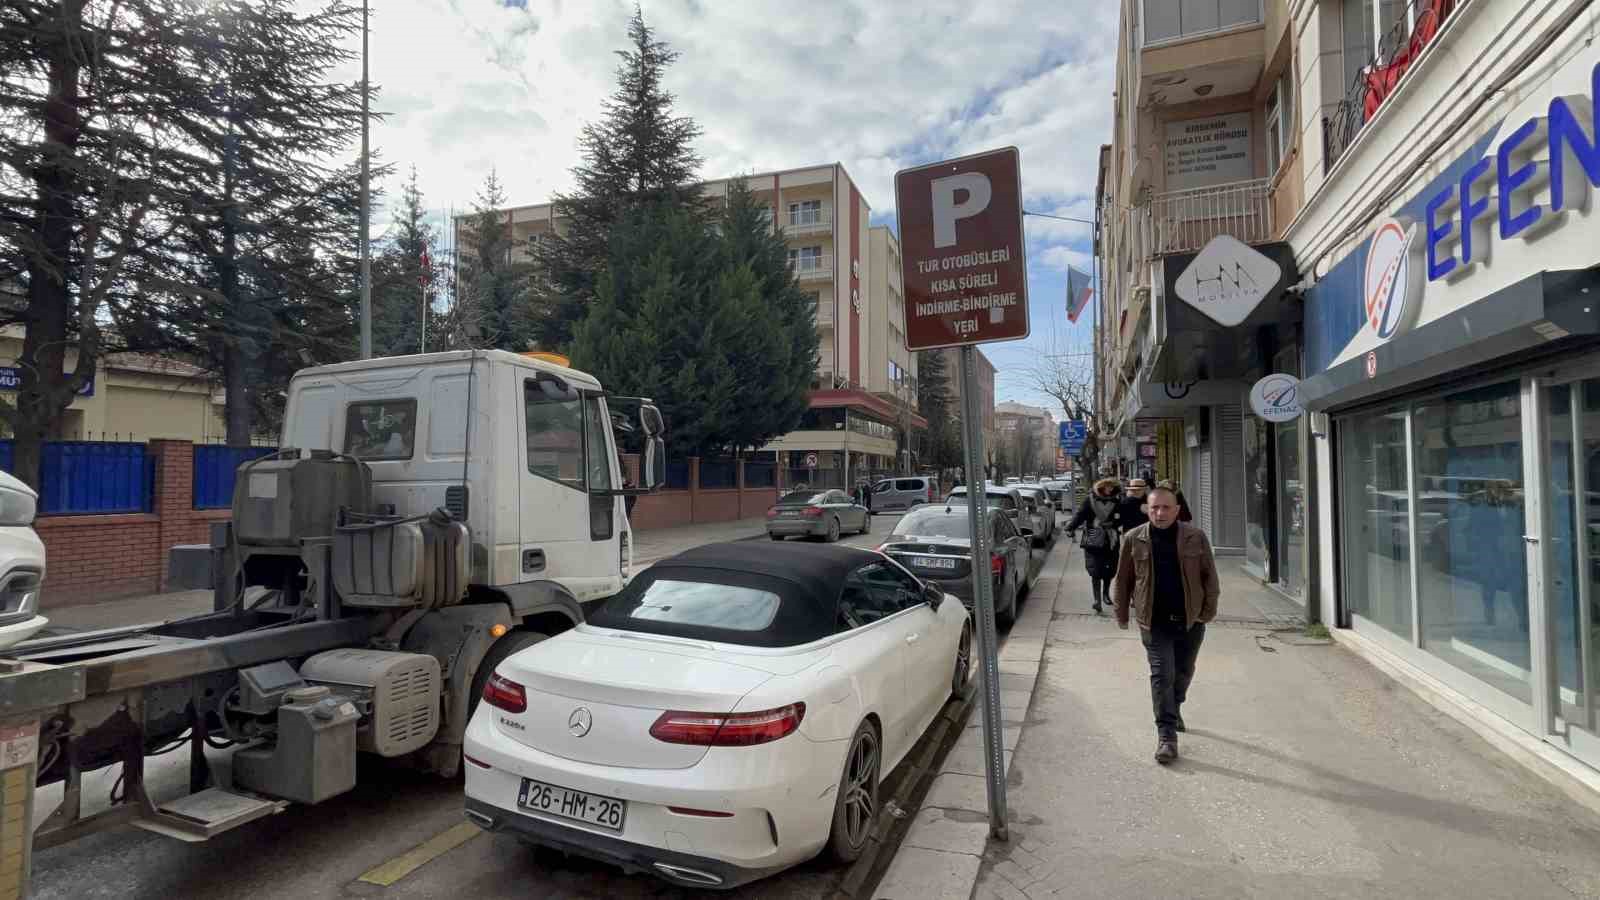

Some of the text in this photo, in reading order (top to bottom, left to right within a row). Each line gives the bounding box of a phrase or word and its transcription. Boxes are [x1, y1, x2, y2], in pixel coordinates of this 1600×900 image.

[930, 171, 992, 249] P
[918, 245, 1010, 275] TUR OTOBÜSLERİ
[931, 270, 998, 295] KISA SÜRELİ
[915, 292, 1017, 317] İNDİRME-BİNDİRME
[953, 317, 979, 335] YERİ
[530, 784, 621, 826] 26-HM-26
